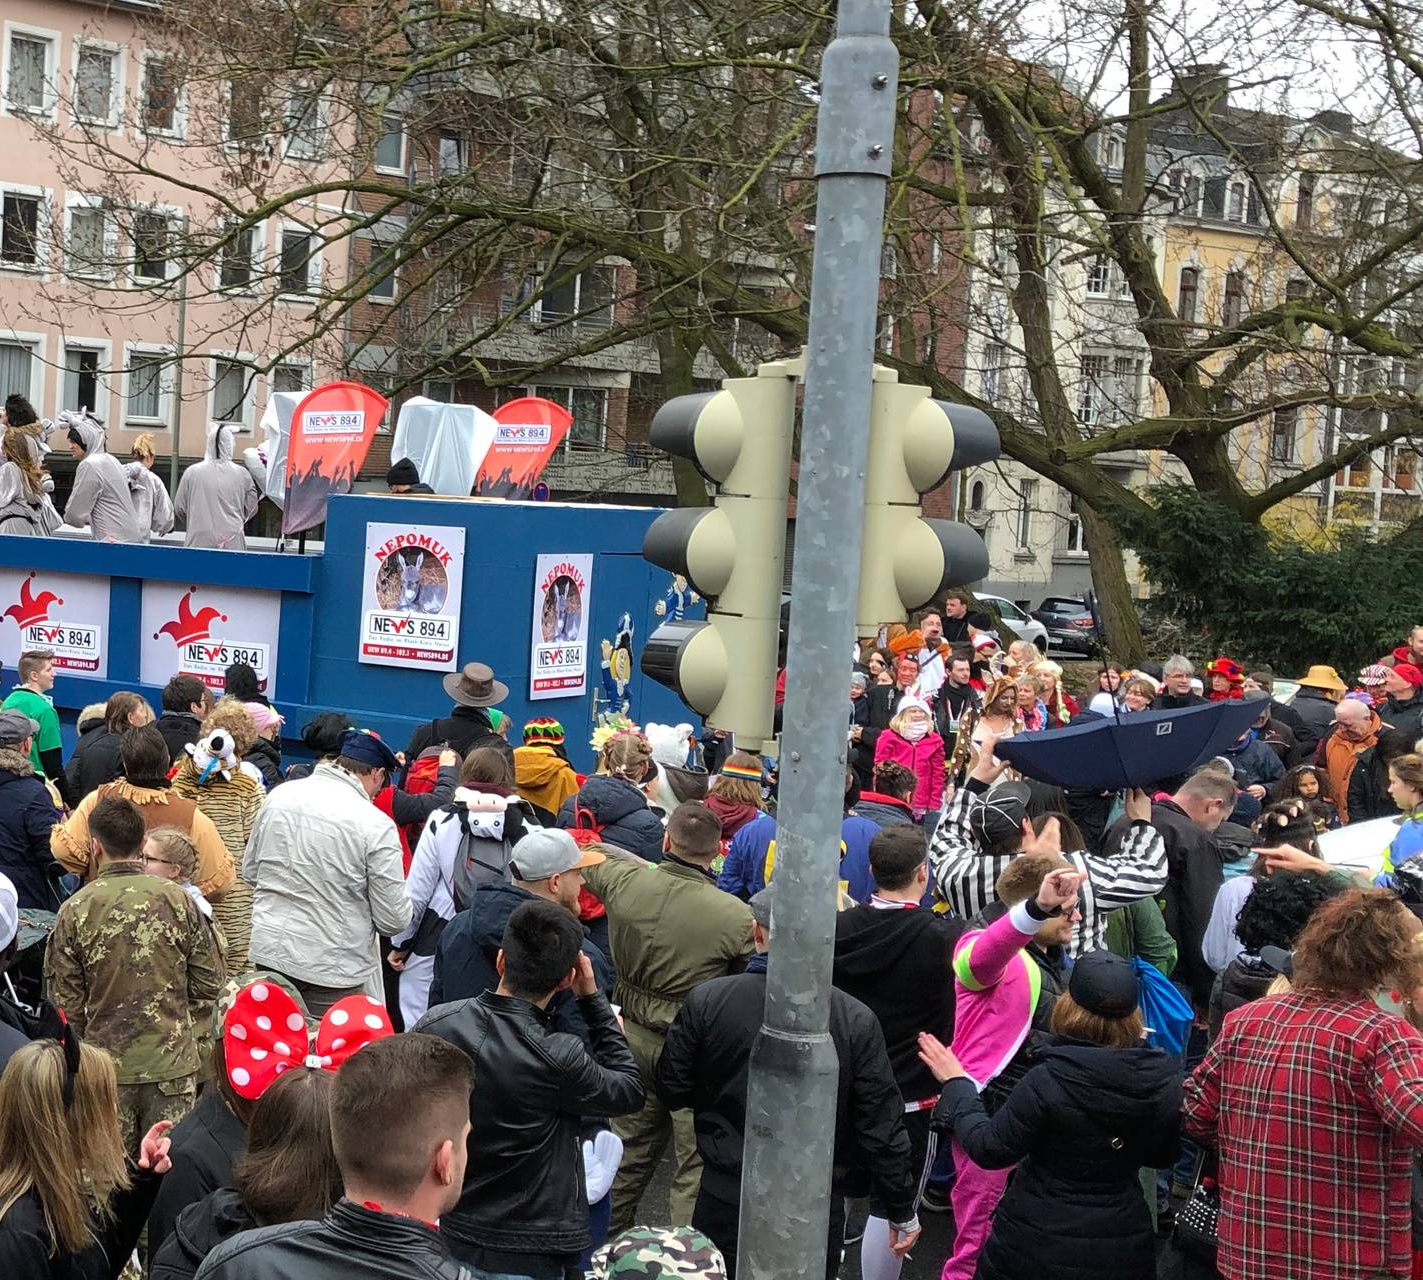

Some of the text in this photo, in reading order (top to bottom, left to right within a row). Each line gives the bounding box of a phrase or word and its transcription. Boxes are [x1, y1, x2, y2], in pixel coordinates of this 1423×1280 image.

[309, 415, 337, 426] NEWS
[499, 428, 526, 438] NEWS
[374, 533, 454, 568] NEPOMUK
[541, 562, 586, 594] NEPOMUK
[29, 625, 91, 647] NEWS 89.4
[374, 616, 445, 638] NEWS 89.4
[188, 643, 258, 667] NEWS 89.4
[367, 646, 380, 654] UKW
[380, 647, 392, 655] 89.4
[416, 650, 449, 661] NEWS894.DE
[539, 649, 564, 666] NEWS
